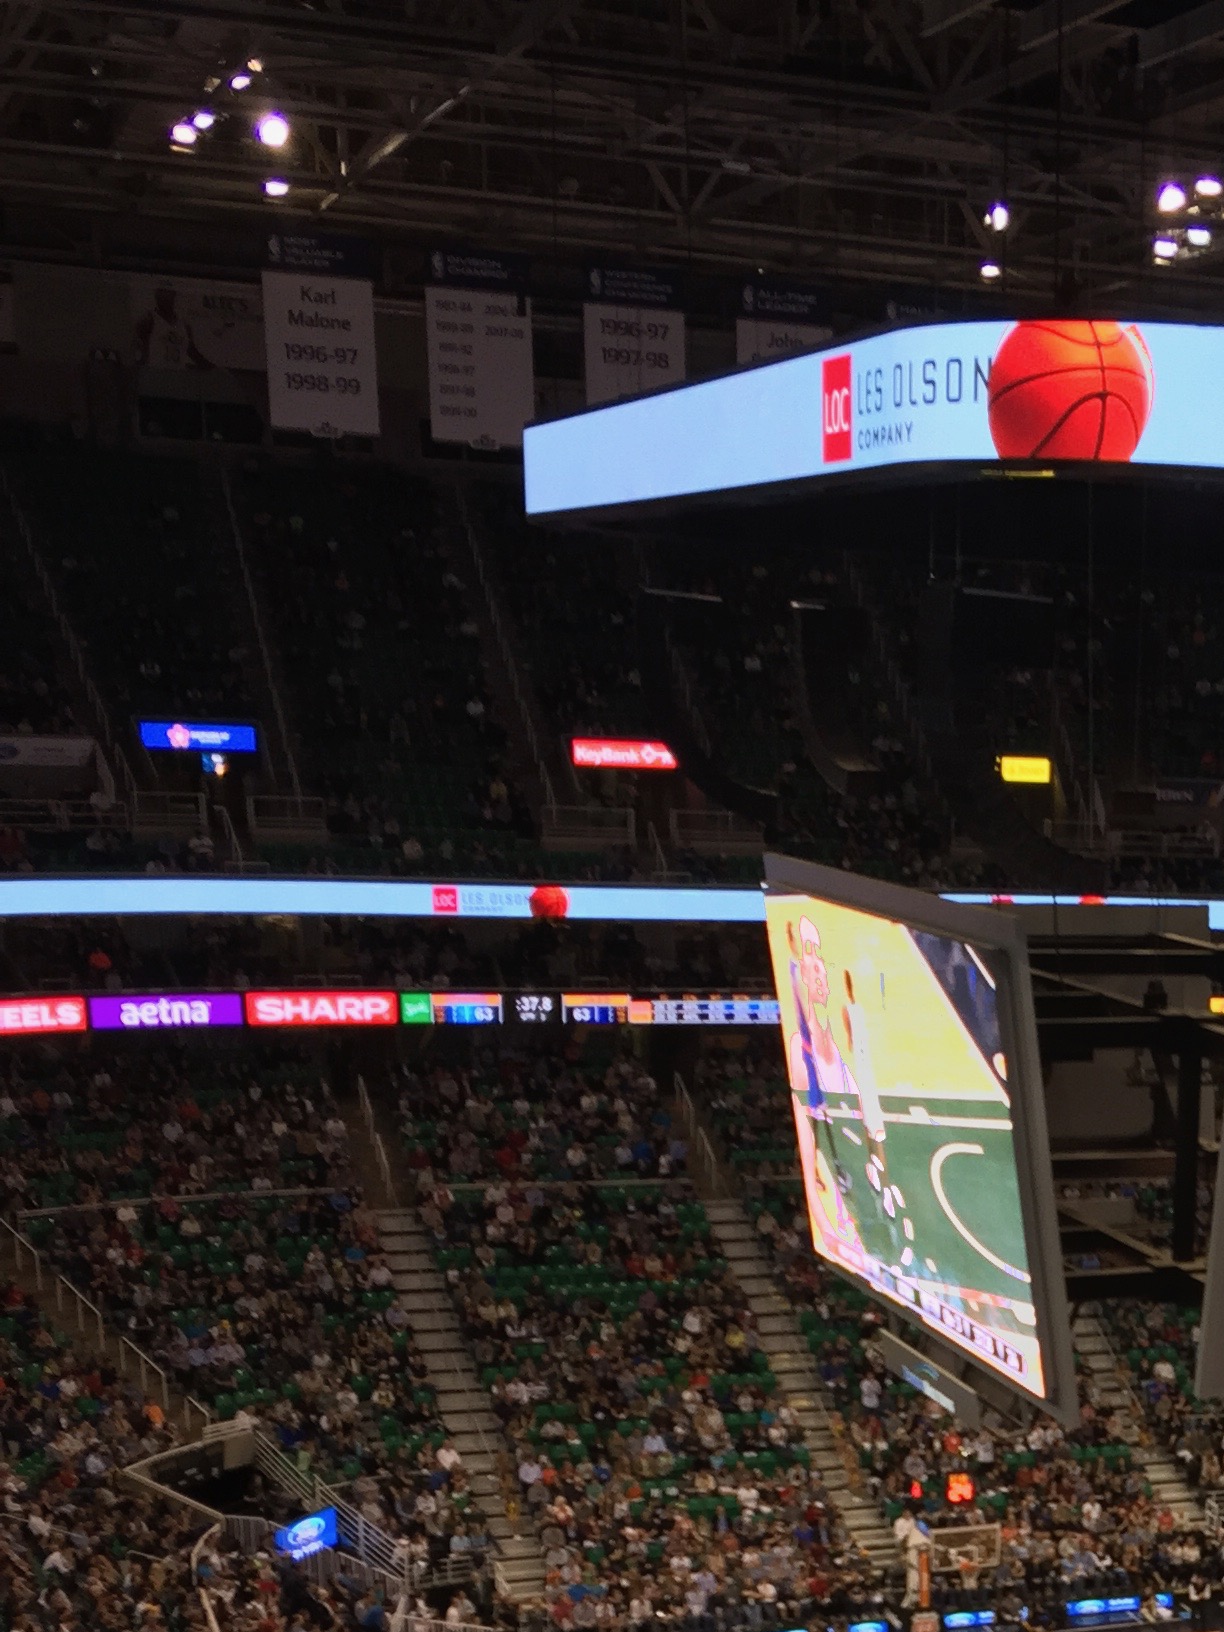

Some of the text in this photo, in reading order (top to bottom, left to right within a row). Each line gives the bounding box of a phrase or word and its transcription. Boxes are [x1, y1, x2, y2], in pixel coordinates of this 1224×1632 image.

[301, 285, 336, 304] Karl
[288, 309, 351, 331] Malone
[284, 342, 358, 365] 1996-97
[284, 371, 361, 395] 1998-99
[856, 367, 883, 416] LES
[824, 386, 849, 434] LOC
[856, 420, 914, 450] COMPANY
[574, 744, 641, 766] KeyBank
[120, 997, 210, 1026] aetna
[254, 996, 390, 1021] SHARP
[473, 1006, 495, 1022] 63
[572, 1007, 593, 1022] 63
